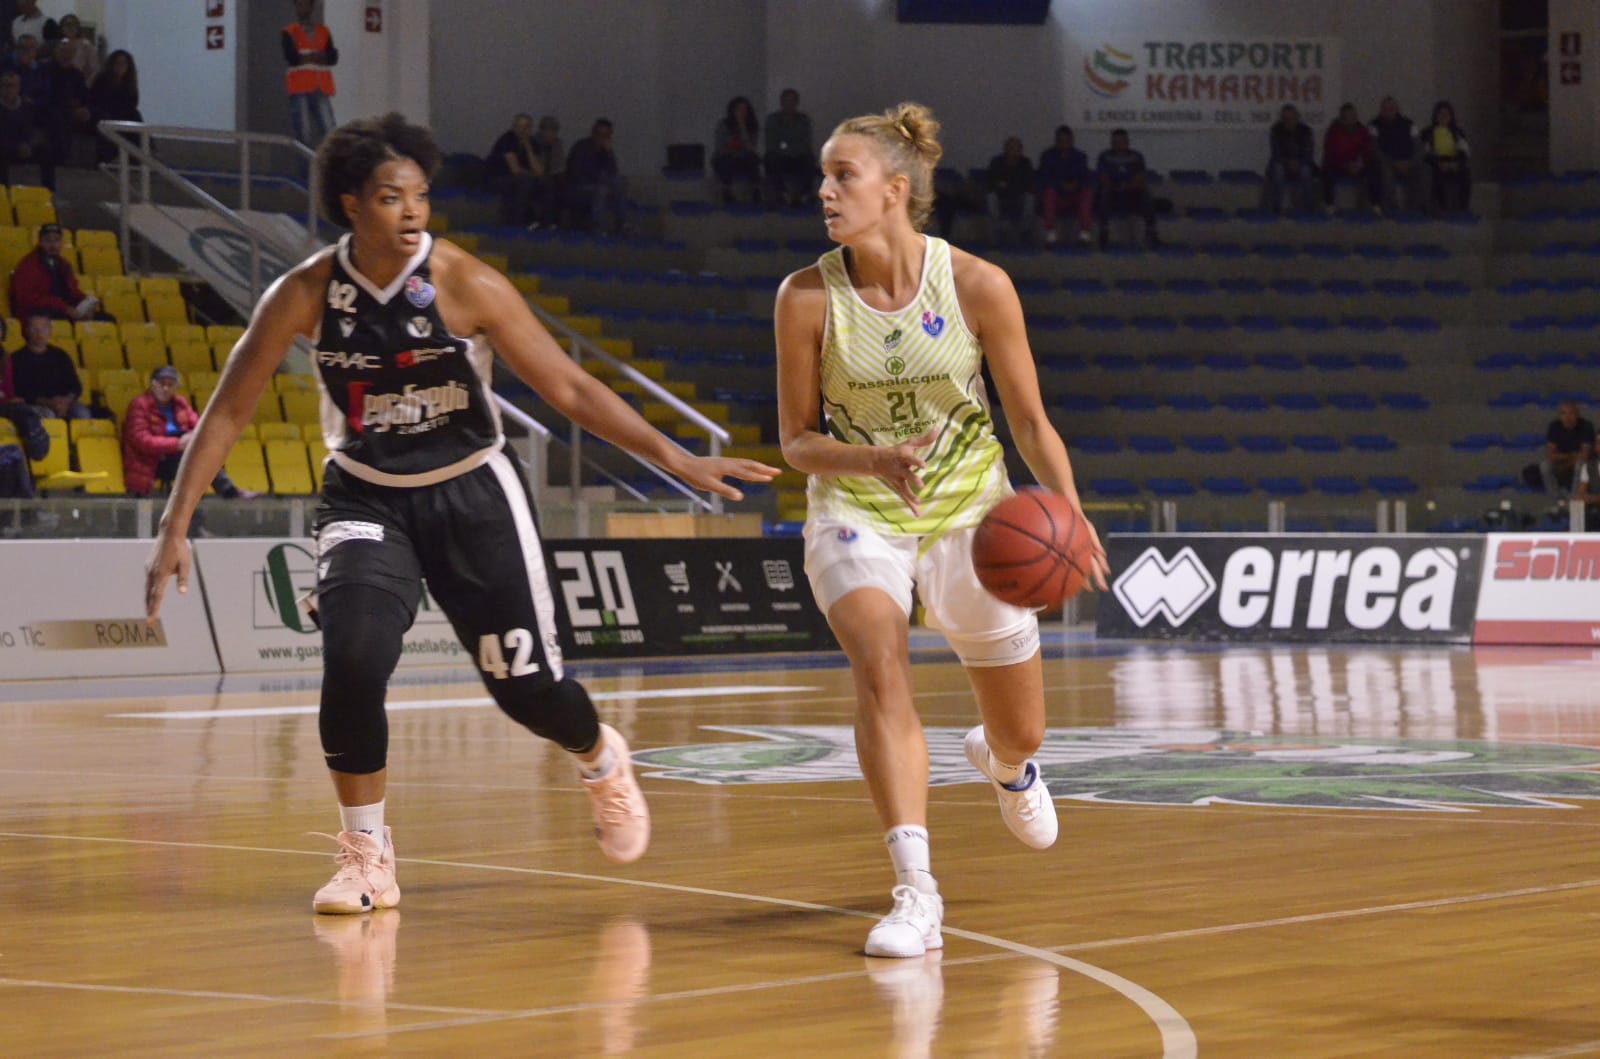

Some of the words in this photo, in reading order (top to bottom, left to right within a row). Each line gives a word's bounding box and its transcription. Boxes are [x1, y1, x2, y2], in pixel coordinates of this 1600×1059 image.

[1144, 42, 1323, 70] TRASPORTI
[1145, 74, 1322, 103] KAMARINA
[327, 280, 358, 314] 42
[318, 351, 383, 370] FAAC
[847, 372, 950, 391] Passalacqua
[887, 391, 919, 424] 21
[553, 550, 640, 627] 20
[94, 622, 160, 646] ROMA
[478, 627, 541, 680] 42
